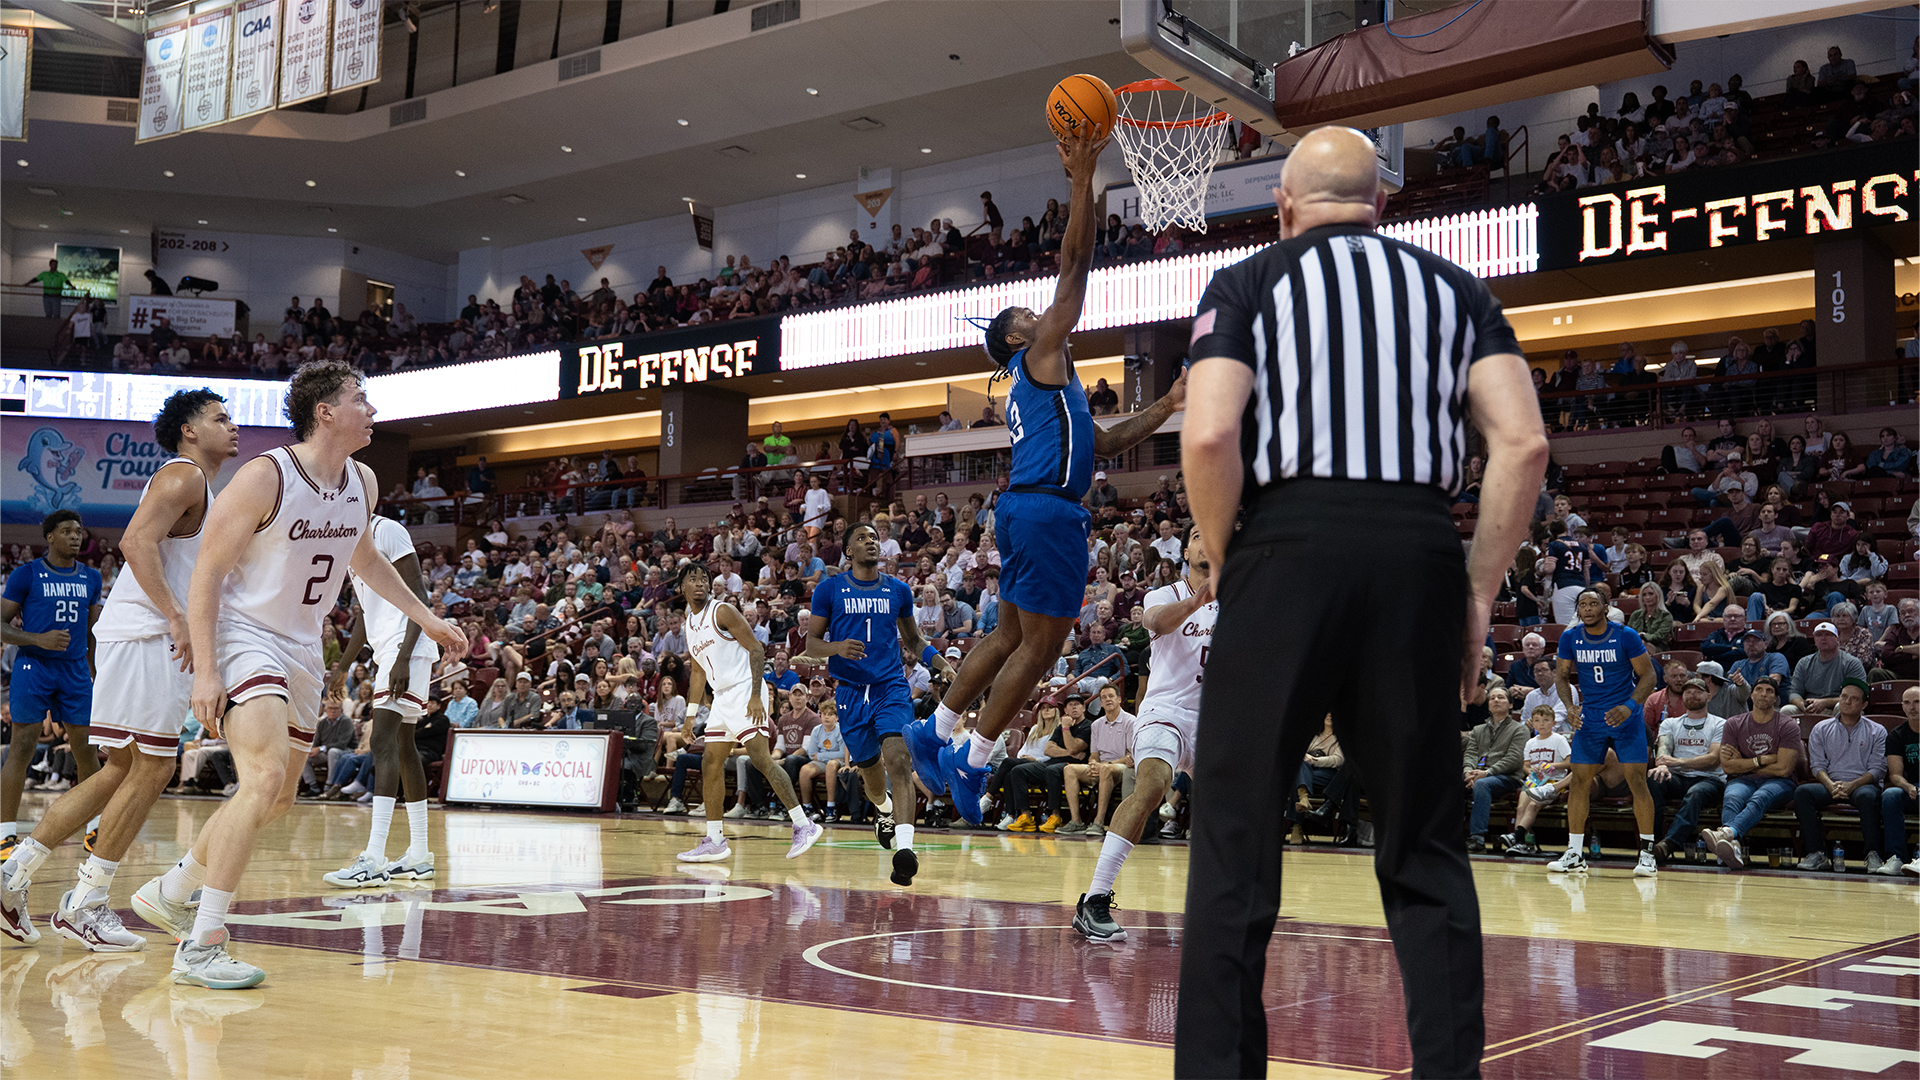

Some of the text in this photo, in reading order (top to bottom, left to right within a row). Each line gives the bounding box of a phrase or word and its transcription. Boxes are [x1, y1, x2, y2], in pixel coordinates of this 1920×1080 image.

[243, 15, 272, 38] CAA
[1054, 100, 1080, 129] NCAA
[1221, 189, 1234, 198] LLC
[160, 238, 217, 251] 202-208
[1832, 270, 1846, 323] 105
[189, 316, 207, 324] Data
[77, 402, 96, 417] 10
[666, 411, 674, 447] 103
[288, 518, 358, 541] Charleston
[1564, 551, 1583, 572] 34
[301, 554, 335, 605] 2
[42, 582, 88, 598] HAMPTON
[55, 600, 79, 623] 25
[843, 597, 890, 614] HAMPTON
[865, 618, 872, 643] 1
[1576, 648, 1618, 663] HAMPTON
[1593, 665, 1605, 684] 8
[461, 758, 593, 778] UPTOWN SOCIAL
